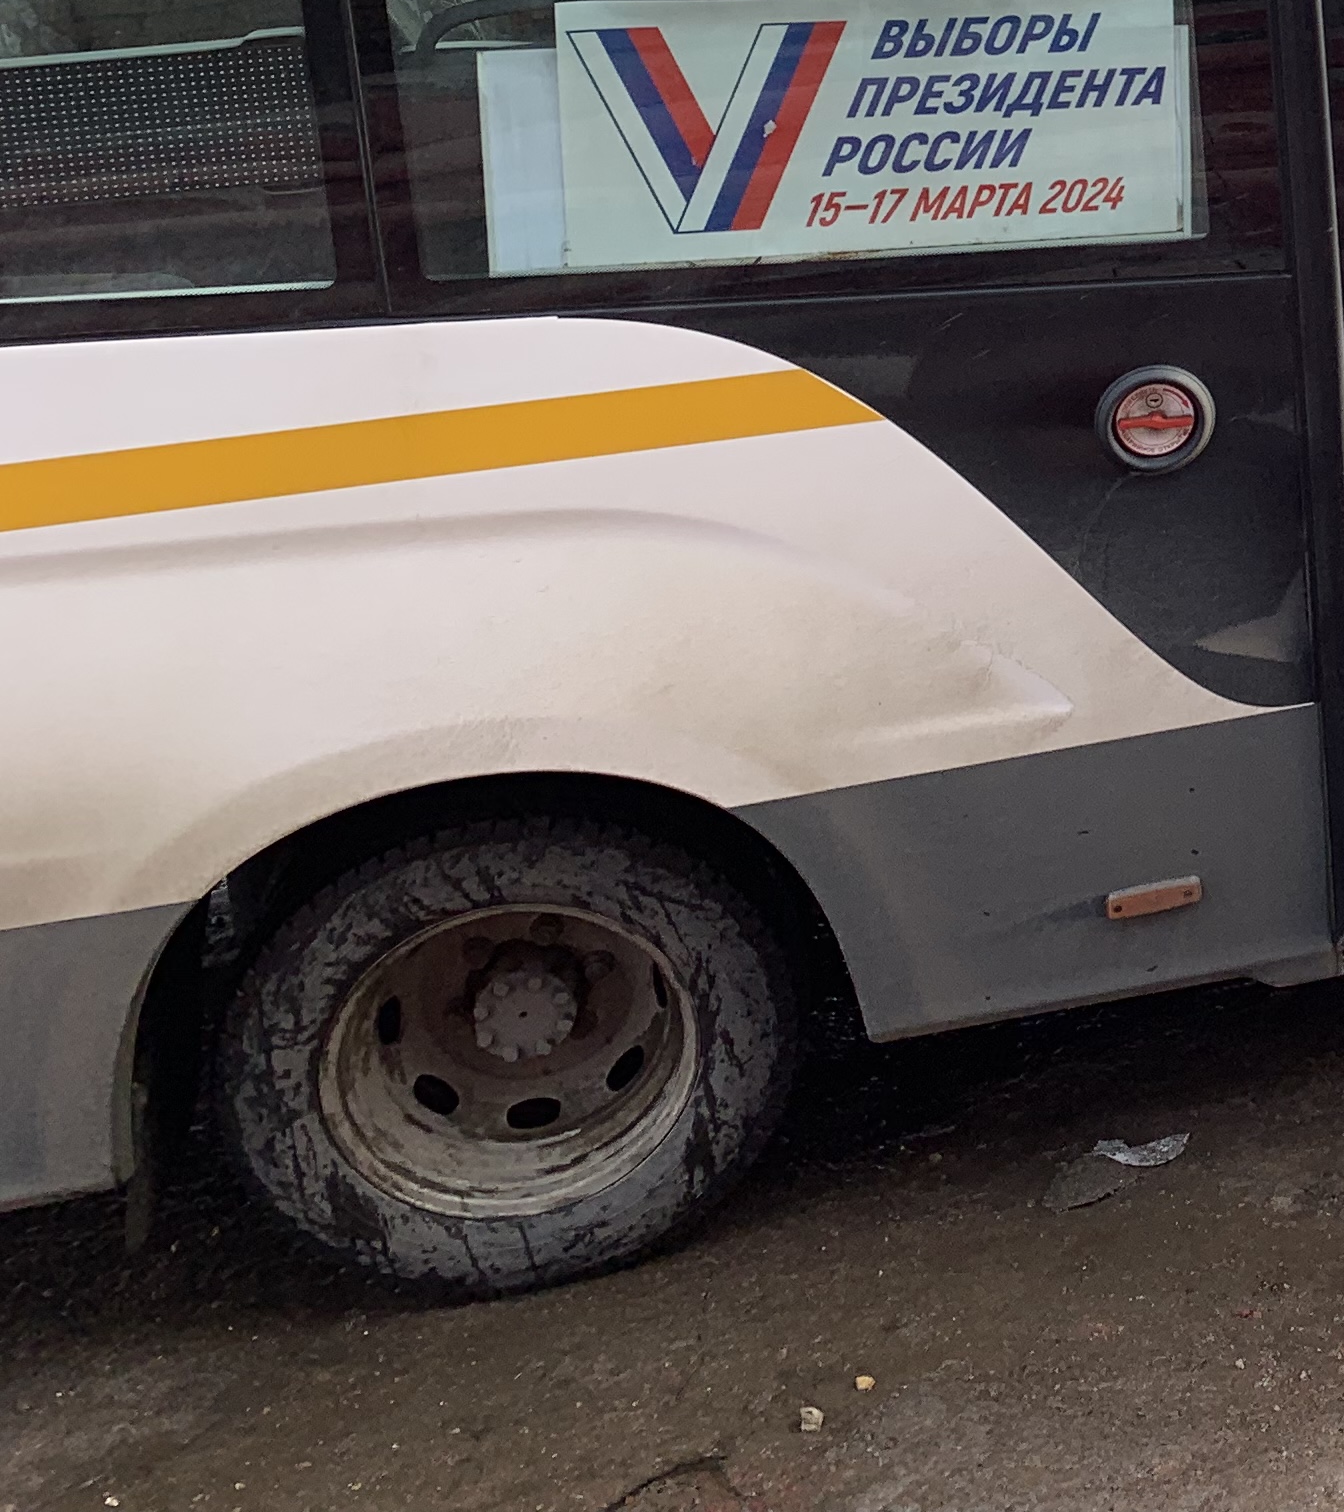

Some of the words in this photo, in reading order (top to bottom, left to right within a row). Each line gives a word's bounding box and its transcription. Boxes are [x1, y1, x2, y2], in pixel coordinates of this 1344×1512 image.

[870, 12, 1102, 60] ВЫБОРЫ
[846, 66, 1166, 118] ПРЕЗИДЕНТА
[822, 128, 1032, 177] РОССИИ
[909, 182, 1032, 222] МАРТА
[1039, 176, 1125, 215] 2024
